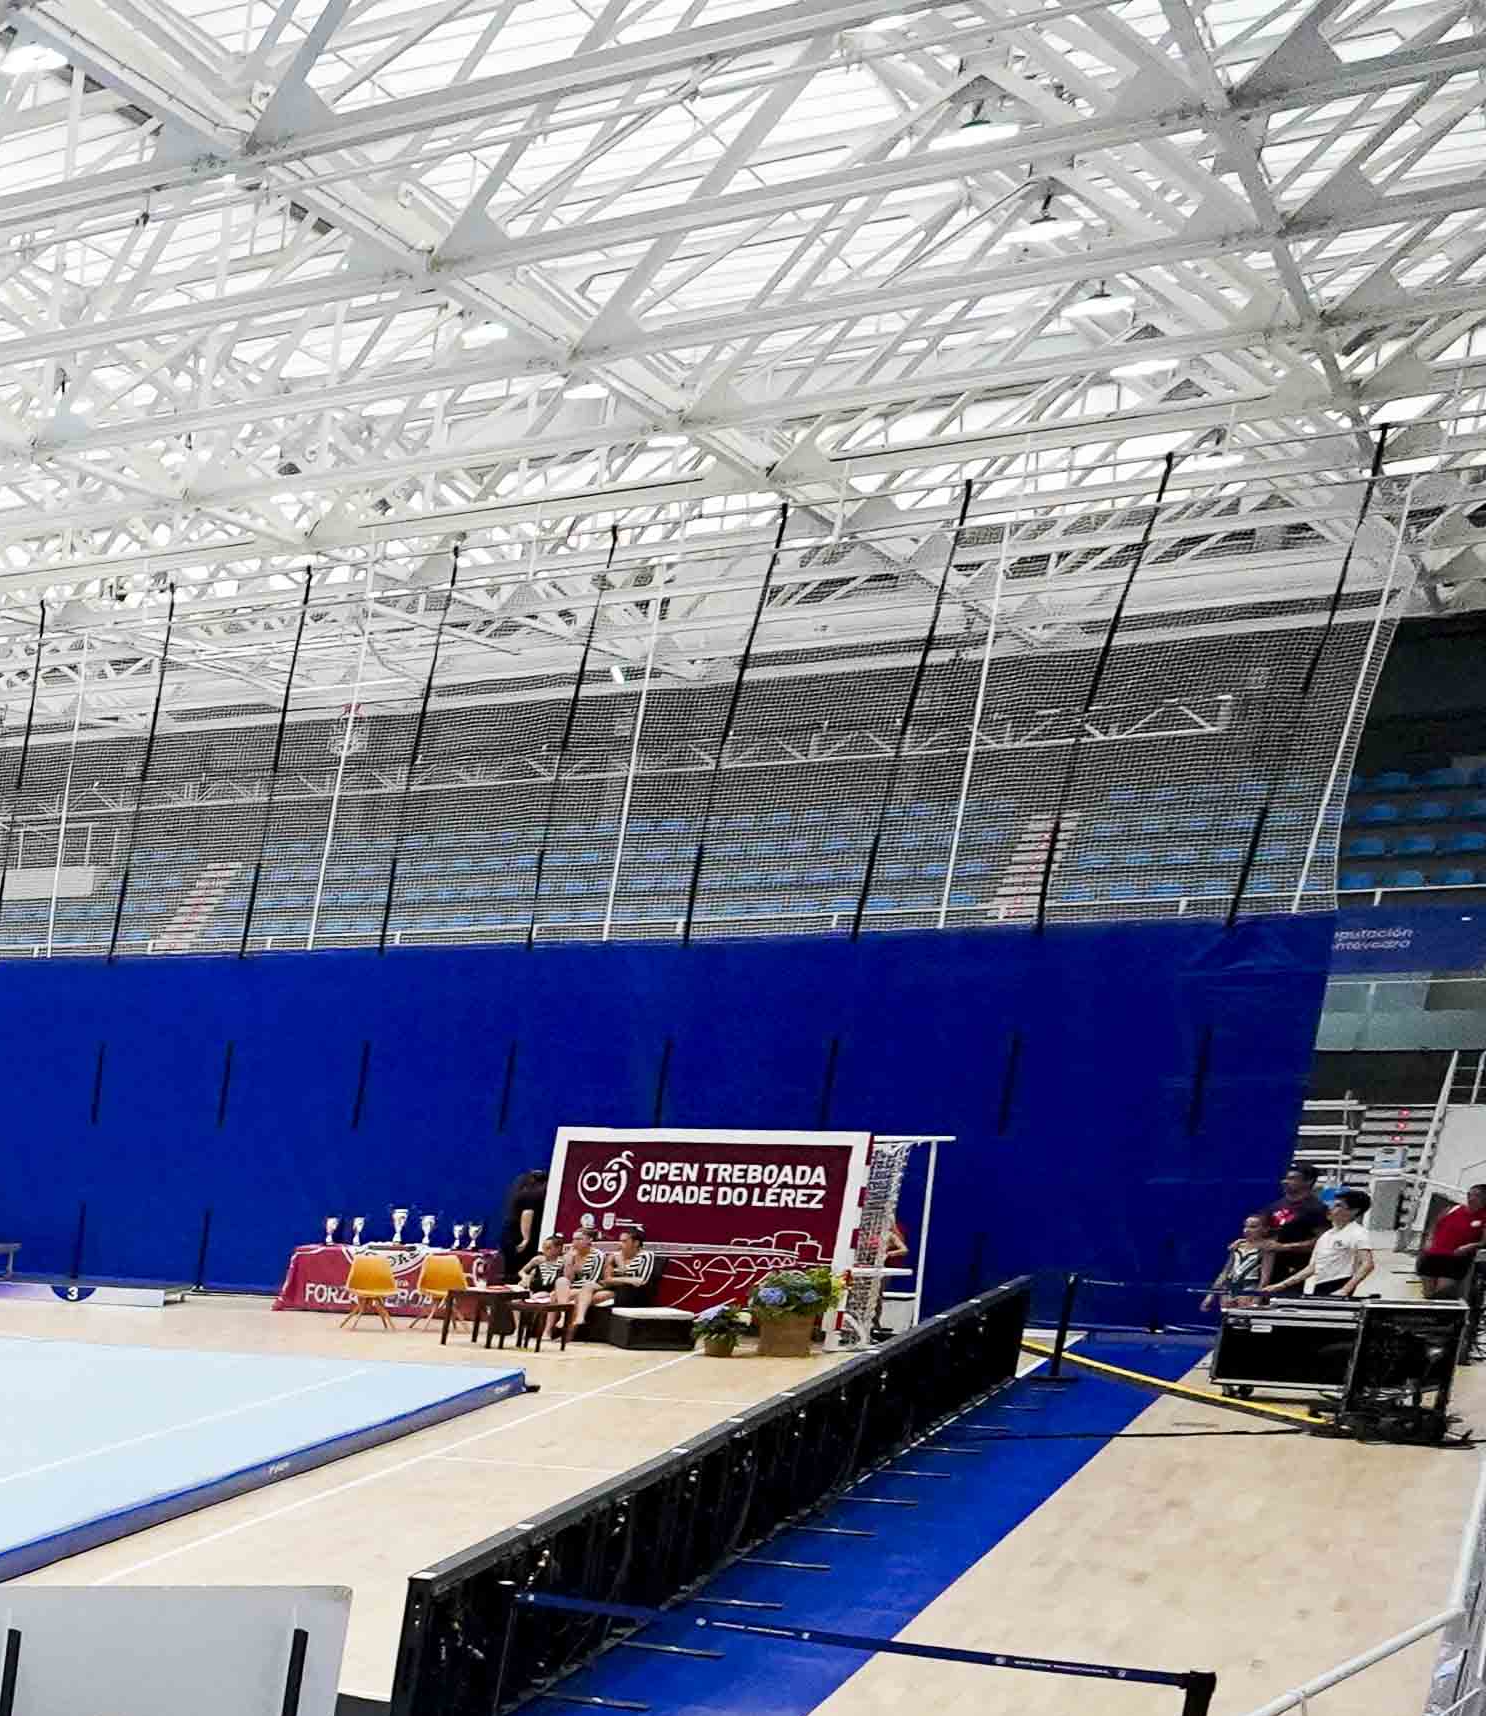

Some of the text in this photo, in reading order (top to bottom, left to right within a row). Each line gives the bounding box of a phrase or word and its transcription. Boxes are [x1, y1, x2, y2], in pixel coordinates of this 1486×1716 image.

[640, 1161, 828, 1186] OPEN TREBOADA
[636, 1184, 827, 1209] CIDADE DO LÉREZ
[67, 1286, 79, 1300] 3
